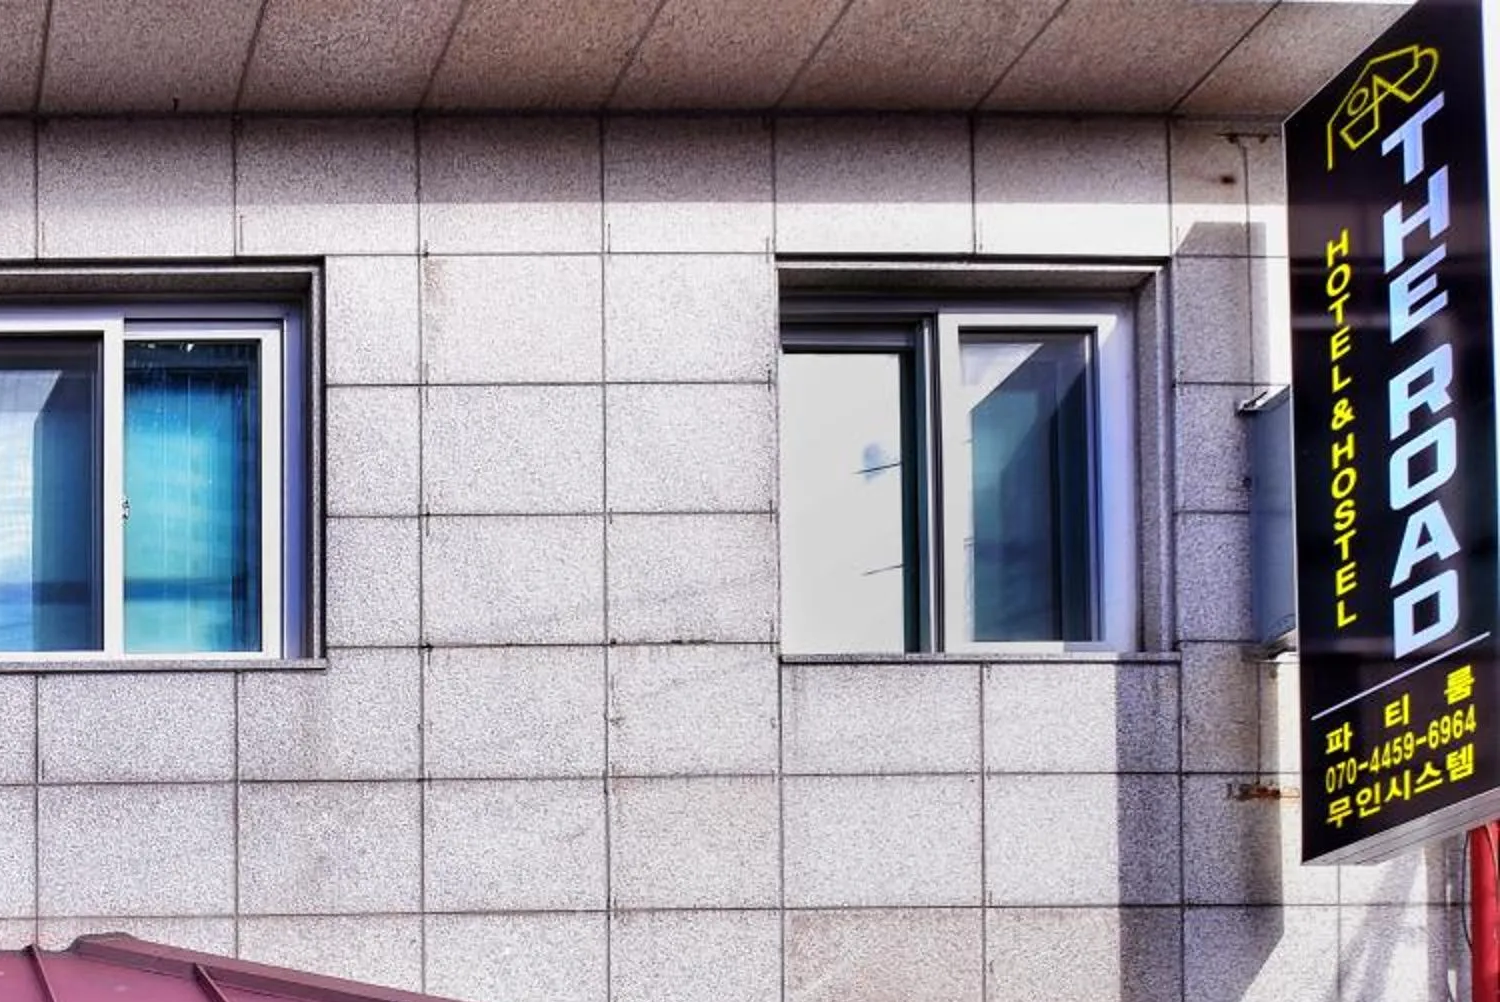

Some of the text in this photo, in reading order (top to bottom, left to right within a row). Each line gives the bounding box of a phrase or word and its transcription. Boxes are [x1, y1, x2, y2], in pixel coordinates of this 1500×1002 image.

[1381, 91, 1461, 659] THE ROAD
[1325, 704, 1477, 793] 070-4459-6964
[1326, 744, 1474, 828] 무인시스템
